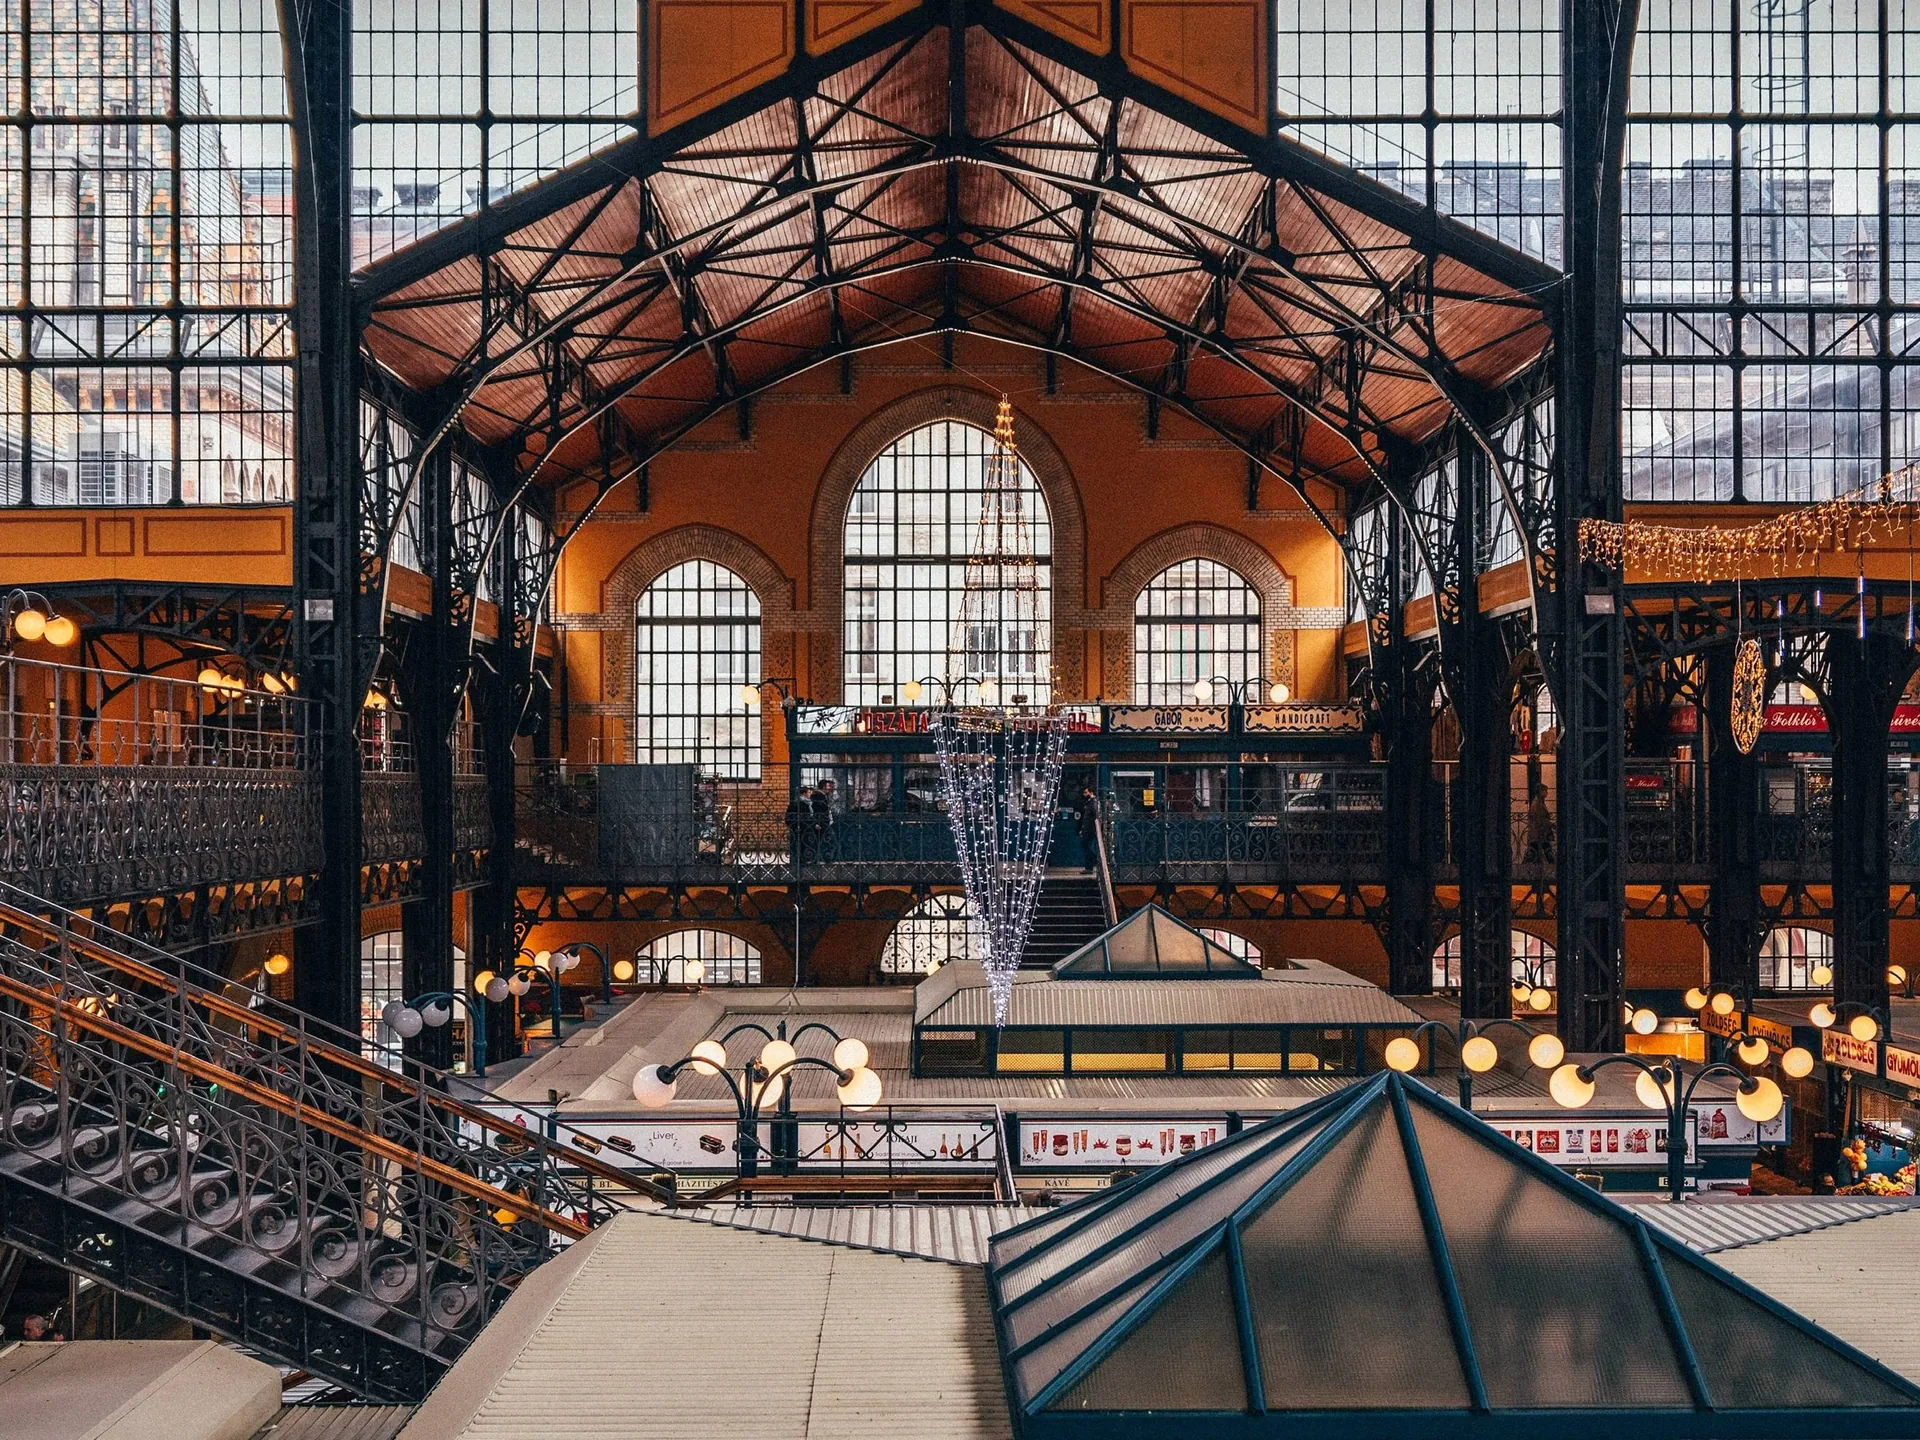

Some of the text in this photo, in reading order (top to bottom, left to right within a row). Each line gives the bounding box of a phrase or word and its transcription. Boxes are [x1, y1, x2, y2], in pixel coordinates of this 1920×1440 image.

[1275, 713, 1331, 725] HANDICRAFT
[1770, 711, 1818, 727] Folklór
[1835, 1037, 1875, 1065] ZÖLDSÉG
[652, 1131, 675, 1141] Liver
